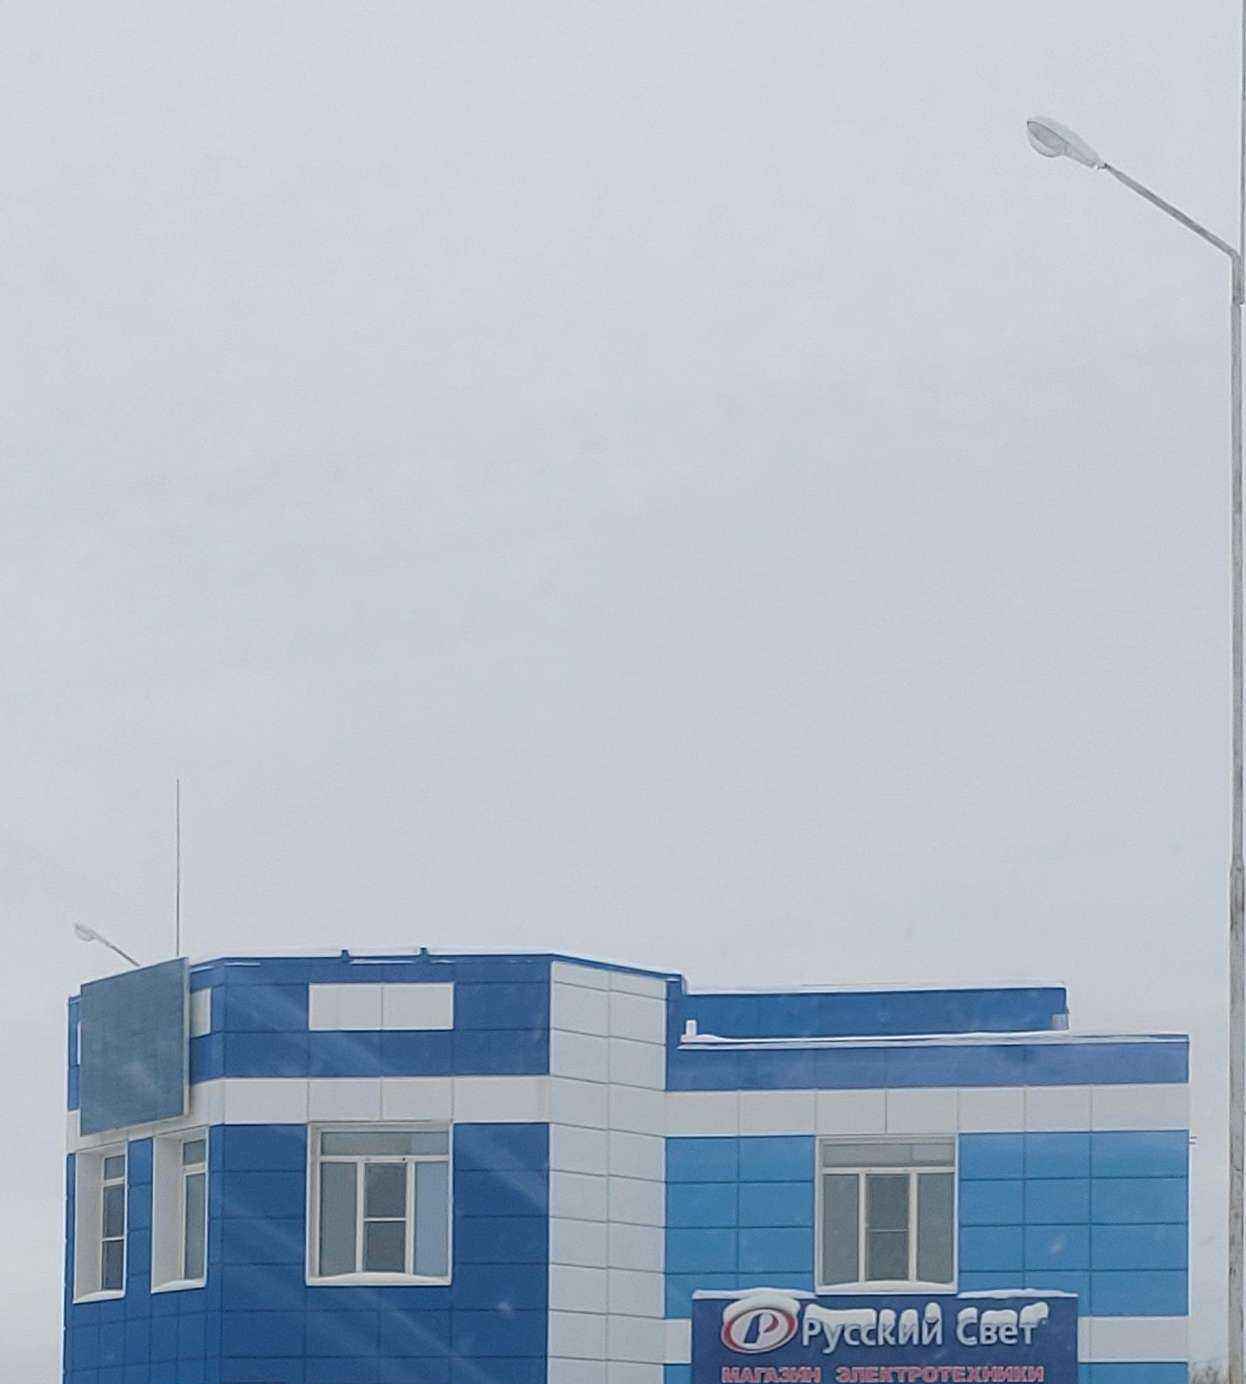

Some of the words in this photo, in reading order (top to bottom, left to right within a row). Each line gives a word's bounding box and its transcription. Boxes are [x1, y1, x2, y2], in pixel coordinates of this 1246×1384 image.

[802, 1311, 944, 1354] Русский
[956, 1311, 1044, 1346] Свет
[722, 1366, 821, 1384] МАГАЗИН
[835, 1365, 1045, 1384] ЭЛЕКТРОТЕХНИКИ
